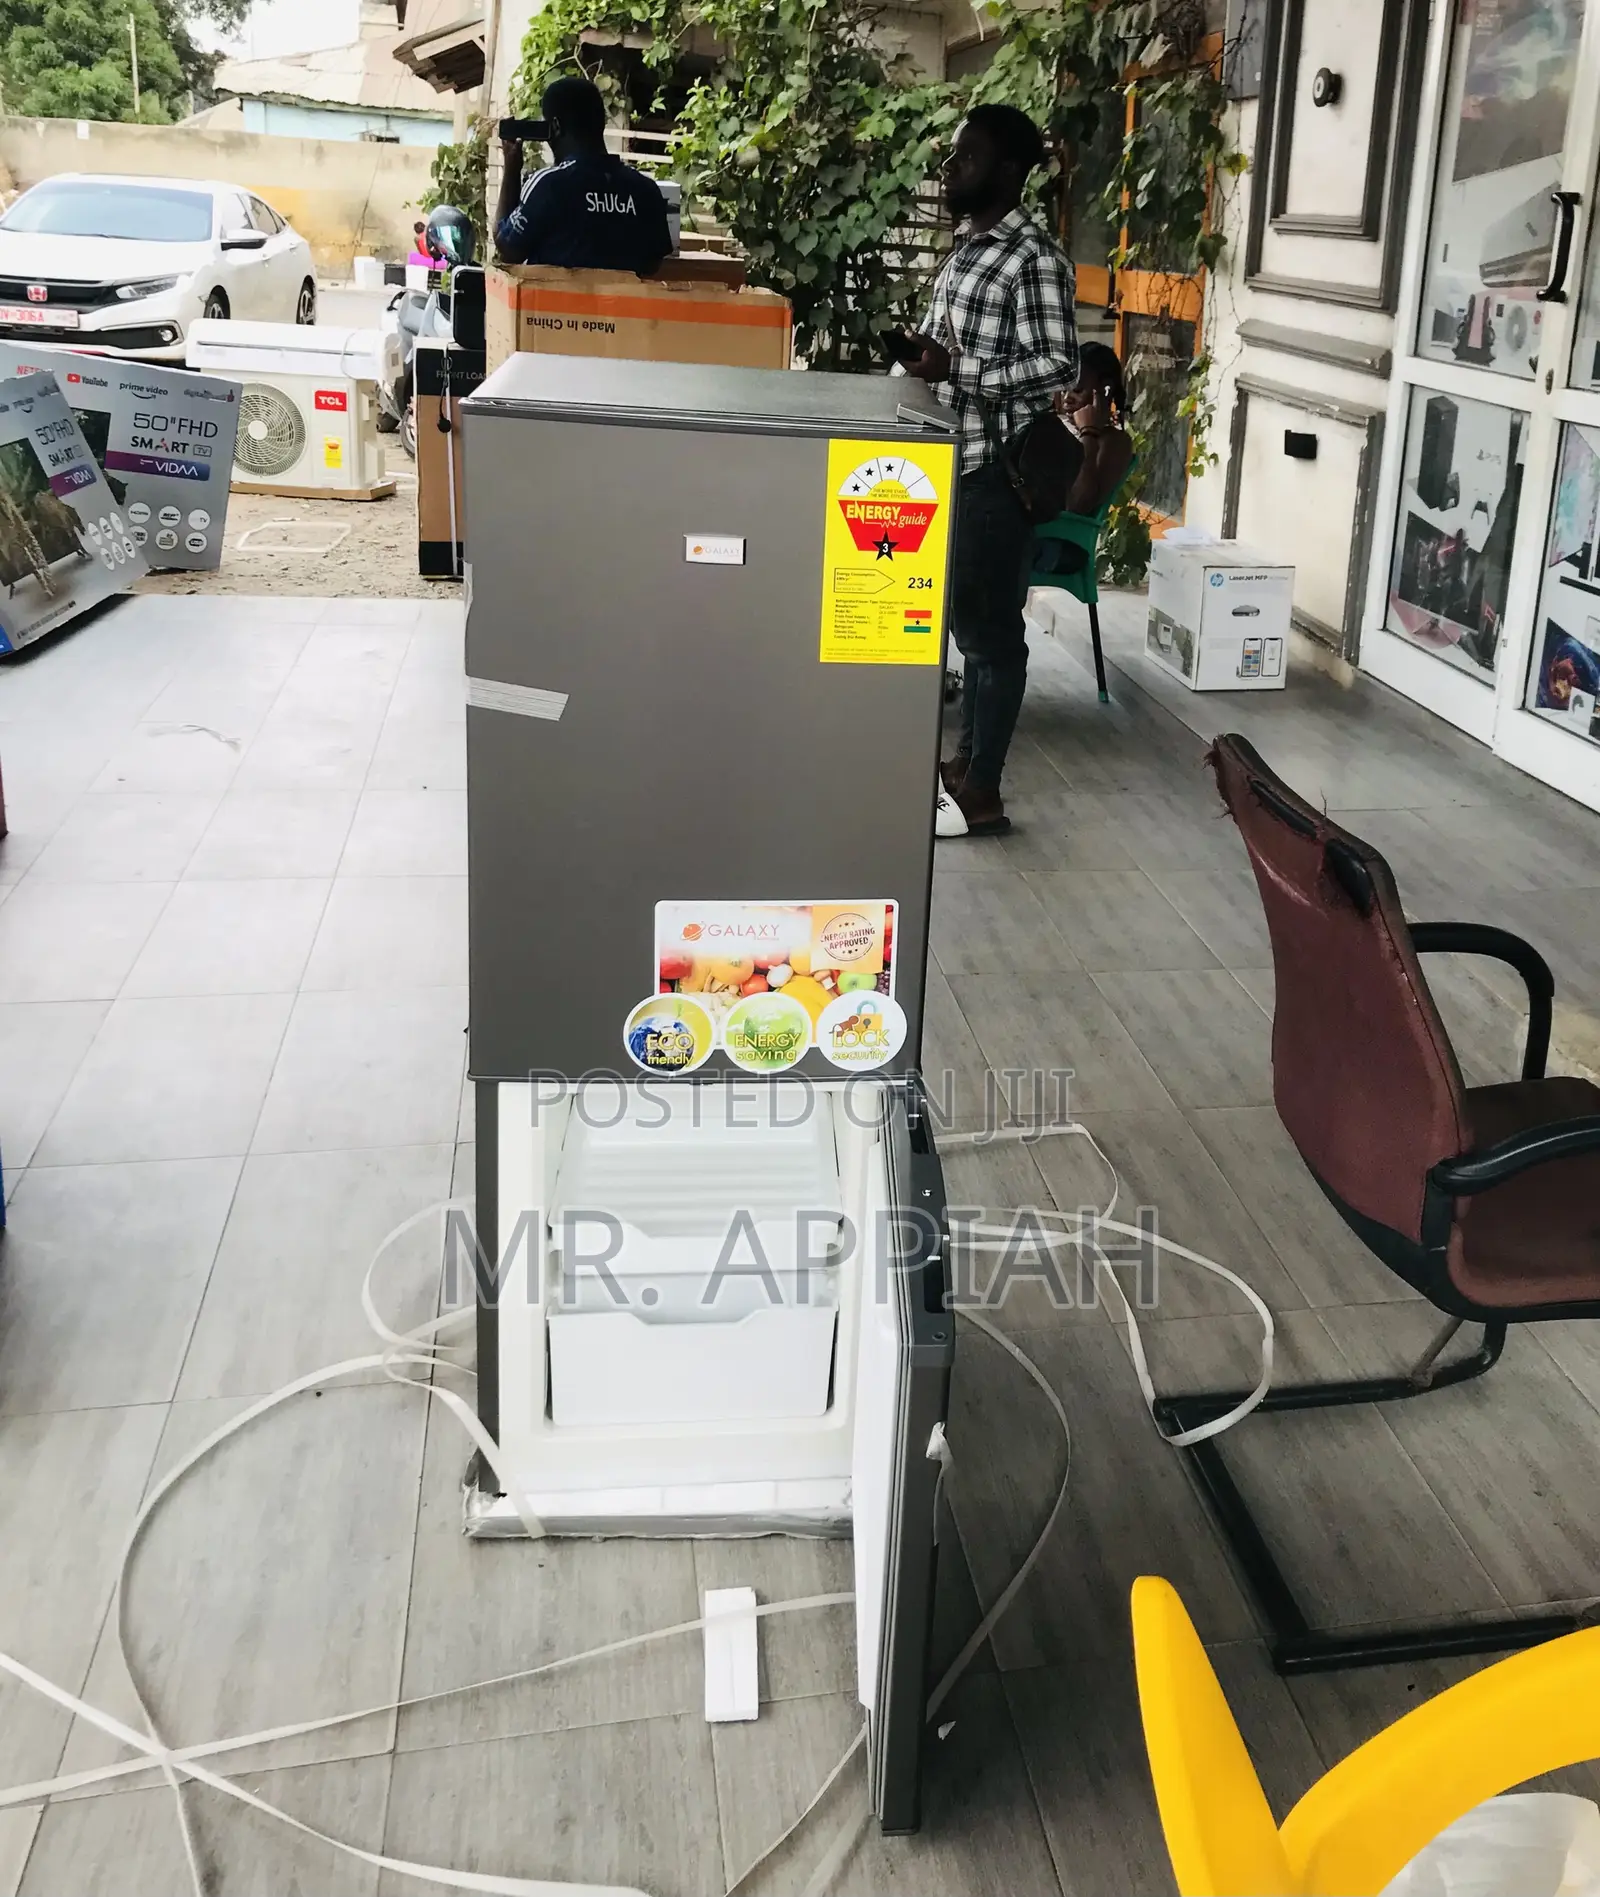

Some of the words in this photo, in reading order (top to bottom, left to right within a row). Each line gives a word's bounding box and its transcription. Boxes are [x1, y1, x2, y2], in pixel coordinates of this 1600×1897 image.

[526, 316, 563, 330] China
[581, 320, 615, 334] Made
[81, 376, 109, 387] YouTube
[119, 382, 145, 392] prime
[145, 386, 169, 396] video
[318, 396, 343, 406] TCL
[130, 435, 190, 454] SMART
[155, 461, 198, 477] VIDAA
[846, 501, 901, 524] ENERGY
[898, 511, 927, 528] guide
[882, 543, 889, 553] 3
[908, 577, 933, 589] 234
[707, 923, 780, 937] GALAXY
[849, 927, 876, 938] RATING
[829, 936, 869, 950] APPROVED
[645, 1033, 695, 1051] ECO
[735, 1032, 800, 1048] ENERGY
[831, 1028, 889, 1047] LOCK
[646, 1051, 695, 1068] friendly
[736, 1047, 797, 1063] saving
[831, 1048, 889, 1062] security
